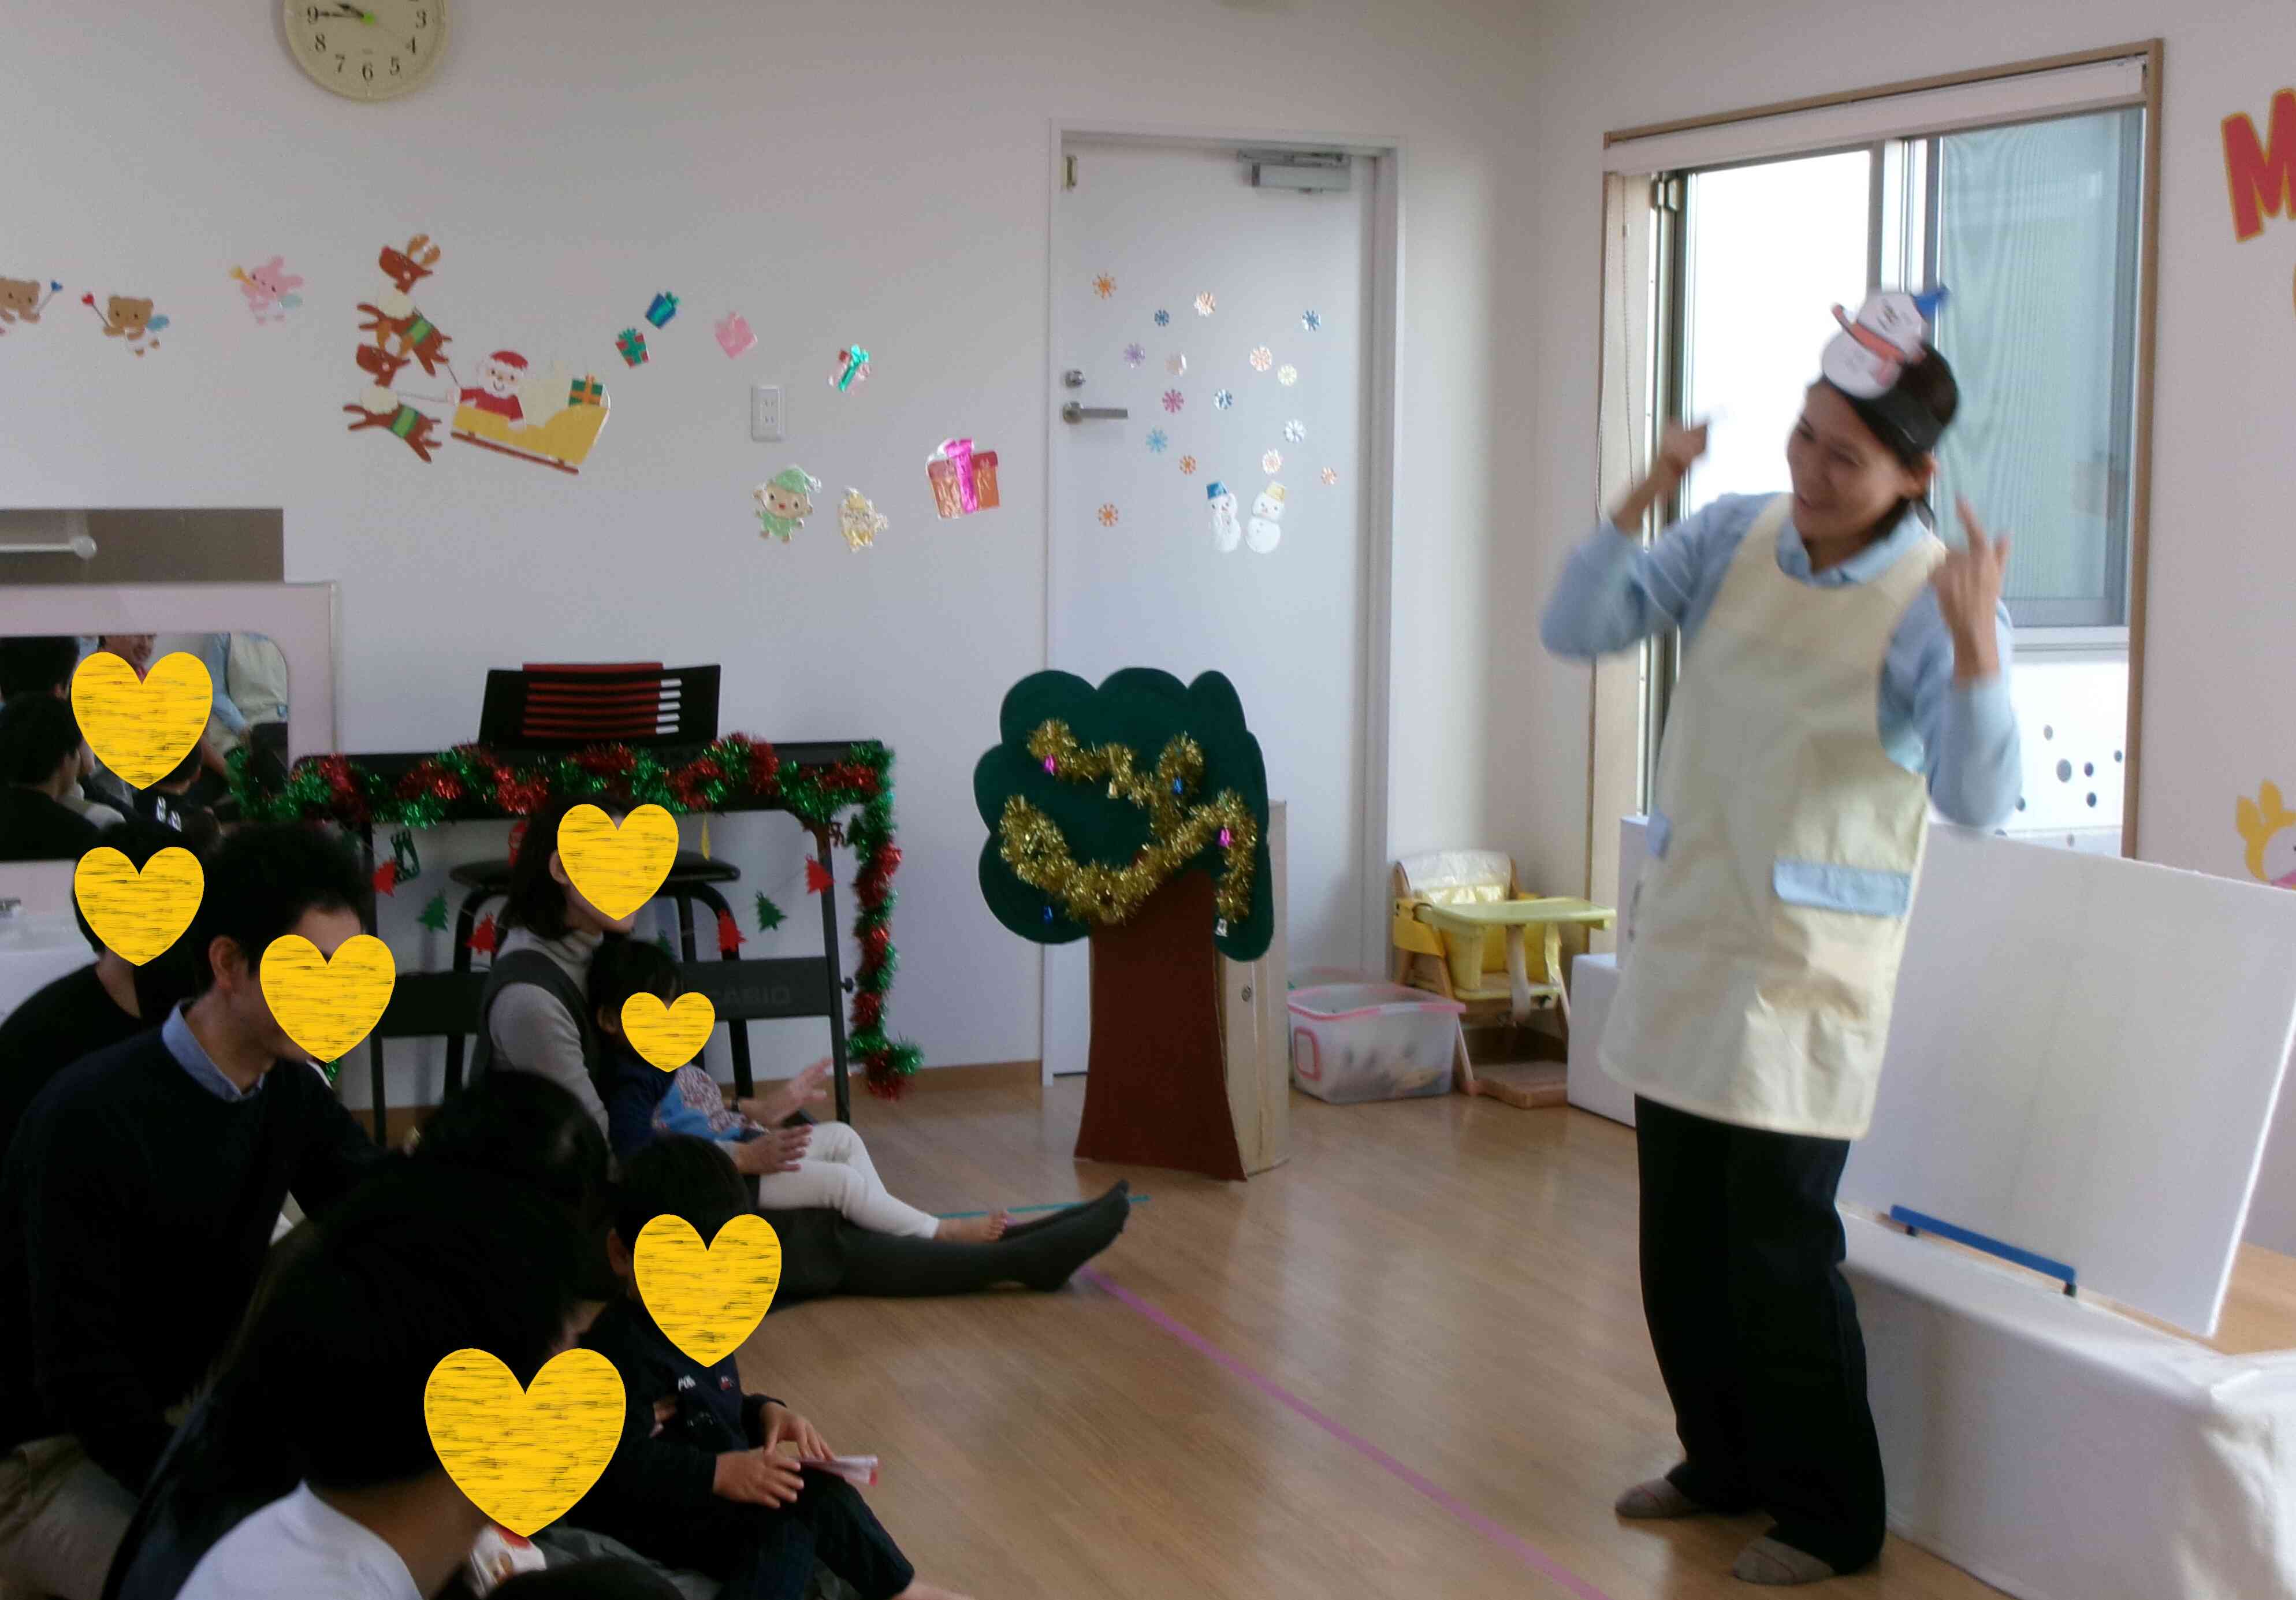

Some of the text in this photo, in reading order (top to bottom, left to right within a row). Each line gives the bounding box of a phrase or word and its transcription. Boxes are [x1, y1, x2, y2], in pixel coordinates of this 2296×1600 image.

[307, 6, 318, 24] 9
[416, 9, 426, 28] 3
[315, 34, 326, 52] 8
[336, 54, 345, 73] 7
[362, 62, 373, 81] 6
[390, 56, 400, 75] 5
